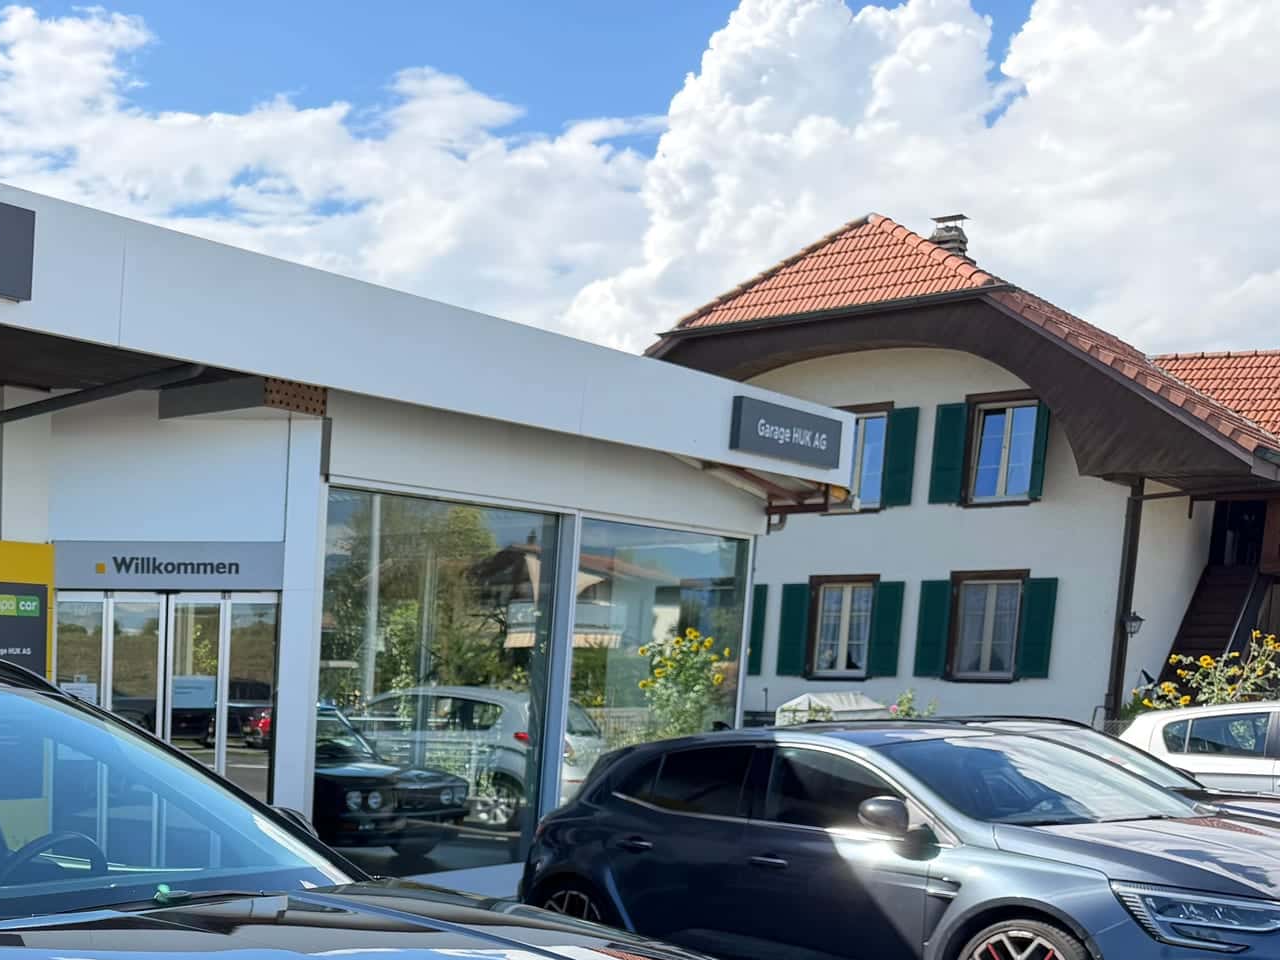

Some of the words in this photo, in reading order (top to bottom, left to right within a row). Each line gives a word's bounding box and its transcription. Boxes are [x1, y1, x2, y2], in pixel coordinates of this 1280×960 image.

[757, 418, 792, 445] Garage
[792, 426, 812, 448] HUK
[812, 432, 828, 450] AG
[112, 556, 240, 575] Willkommen
[18, 600, 38, 611] car
